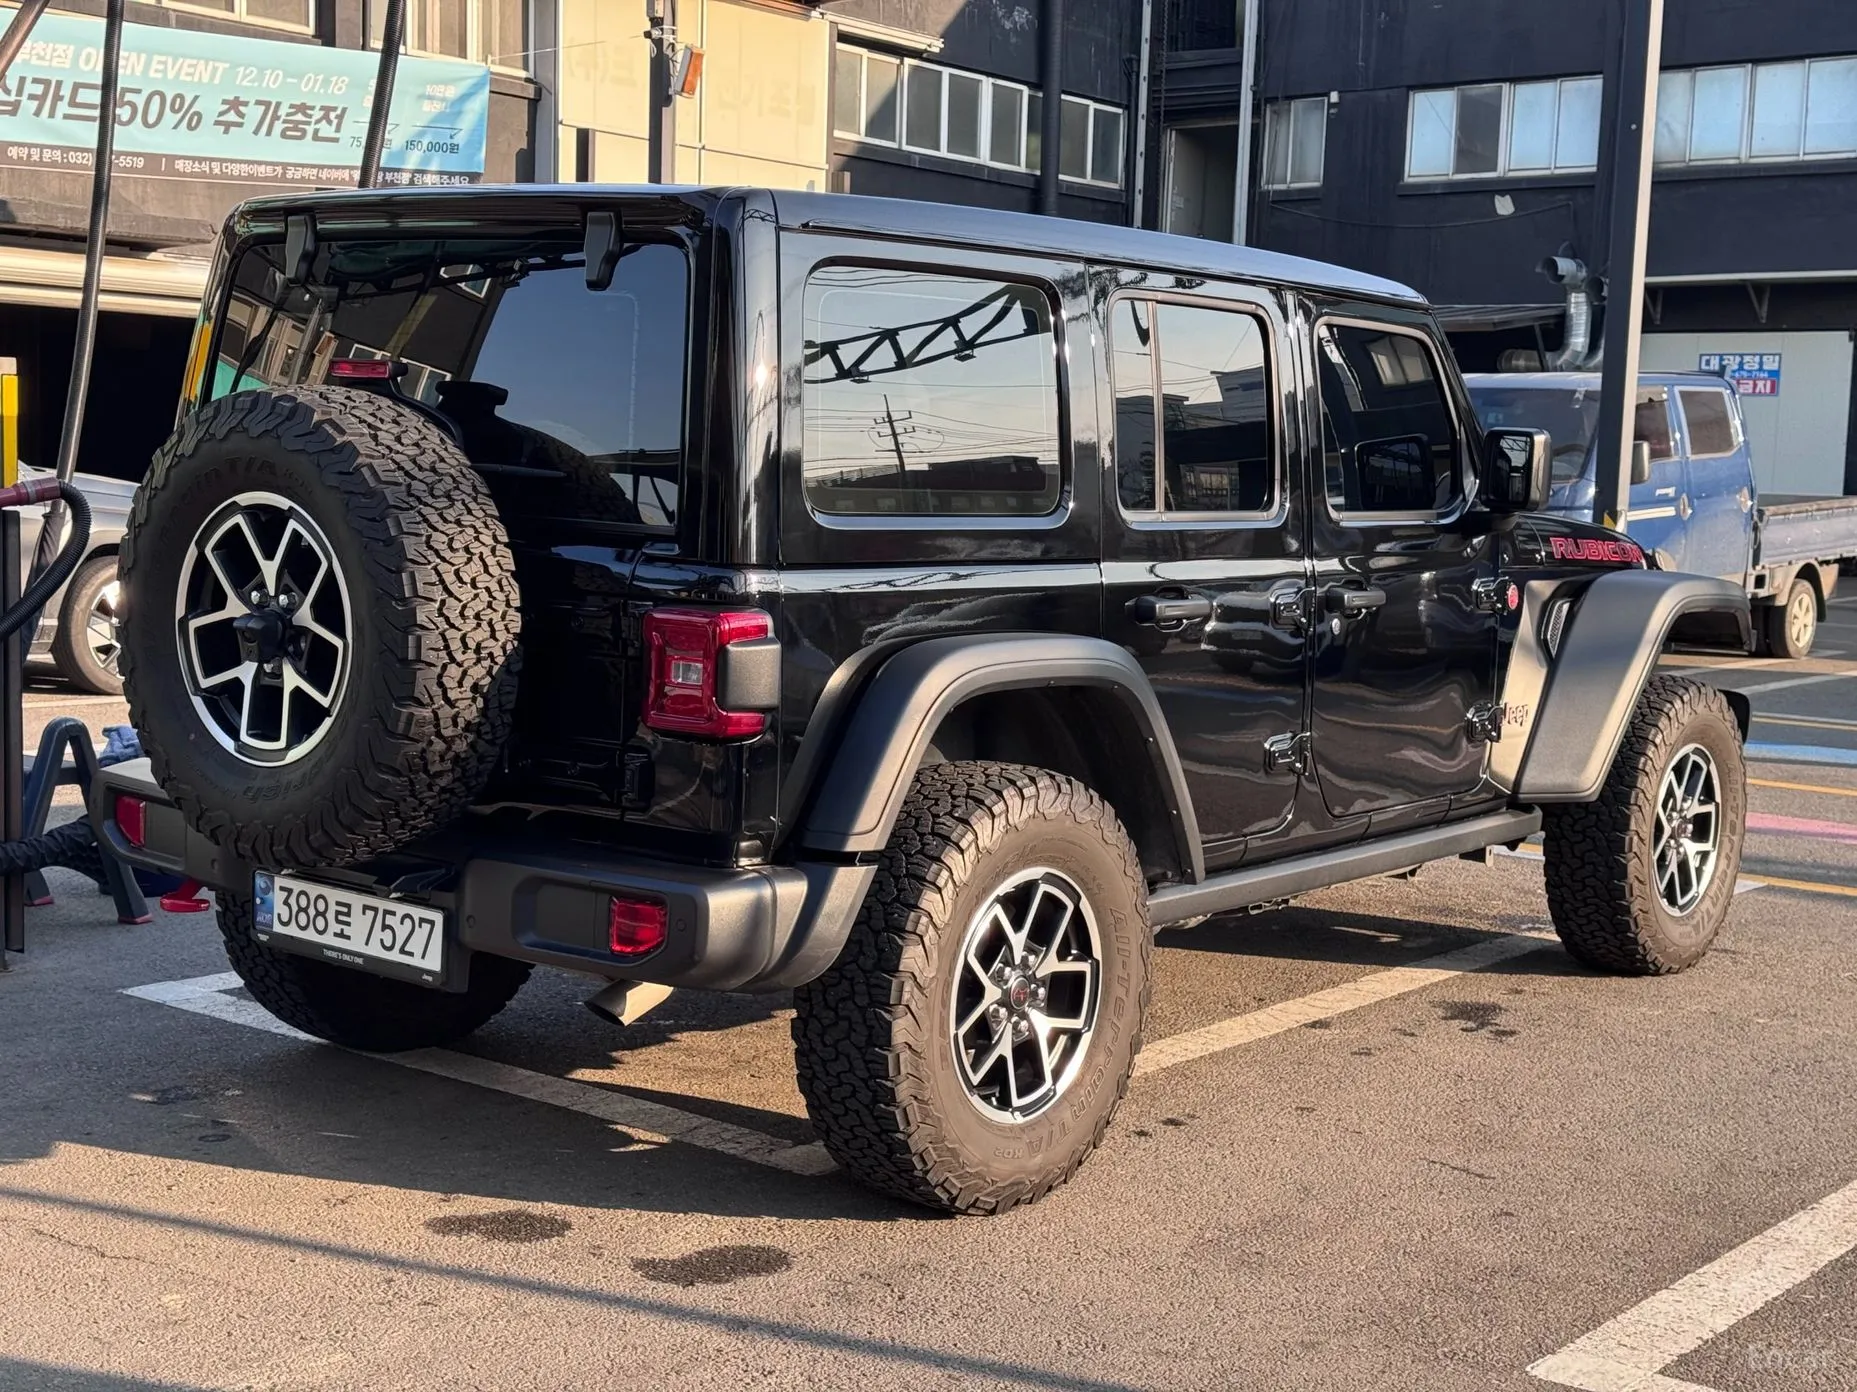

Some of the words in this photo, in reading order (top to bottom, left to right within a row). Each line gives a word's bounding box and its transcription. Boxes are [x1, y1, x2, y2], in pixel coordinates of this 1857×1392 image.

[78, 47, 147, 76] OEN
[148, 55, 230, 84] EVENT
[235, 66, 283, 88] 12.10
[300, 73, 349, 94] 01.18
[115, 87, 202, 132] 50%
[213, 96, 348, 143] 추가충전
[7, 147, 29, 160] 예약
[30, 148, 40, 161] 및
[405, 140, 459, 154] 150,000원
[1550, 537, 1643, 562] RUBICON
[277, 885, 352, 941] 388로
[361, 904, 436, 960] 7527
